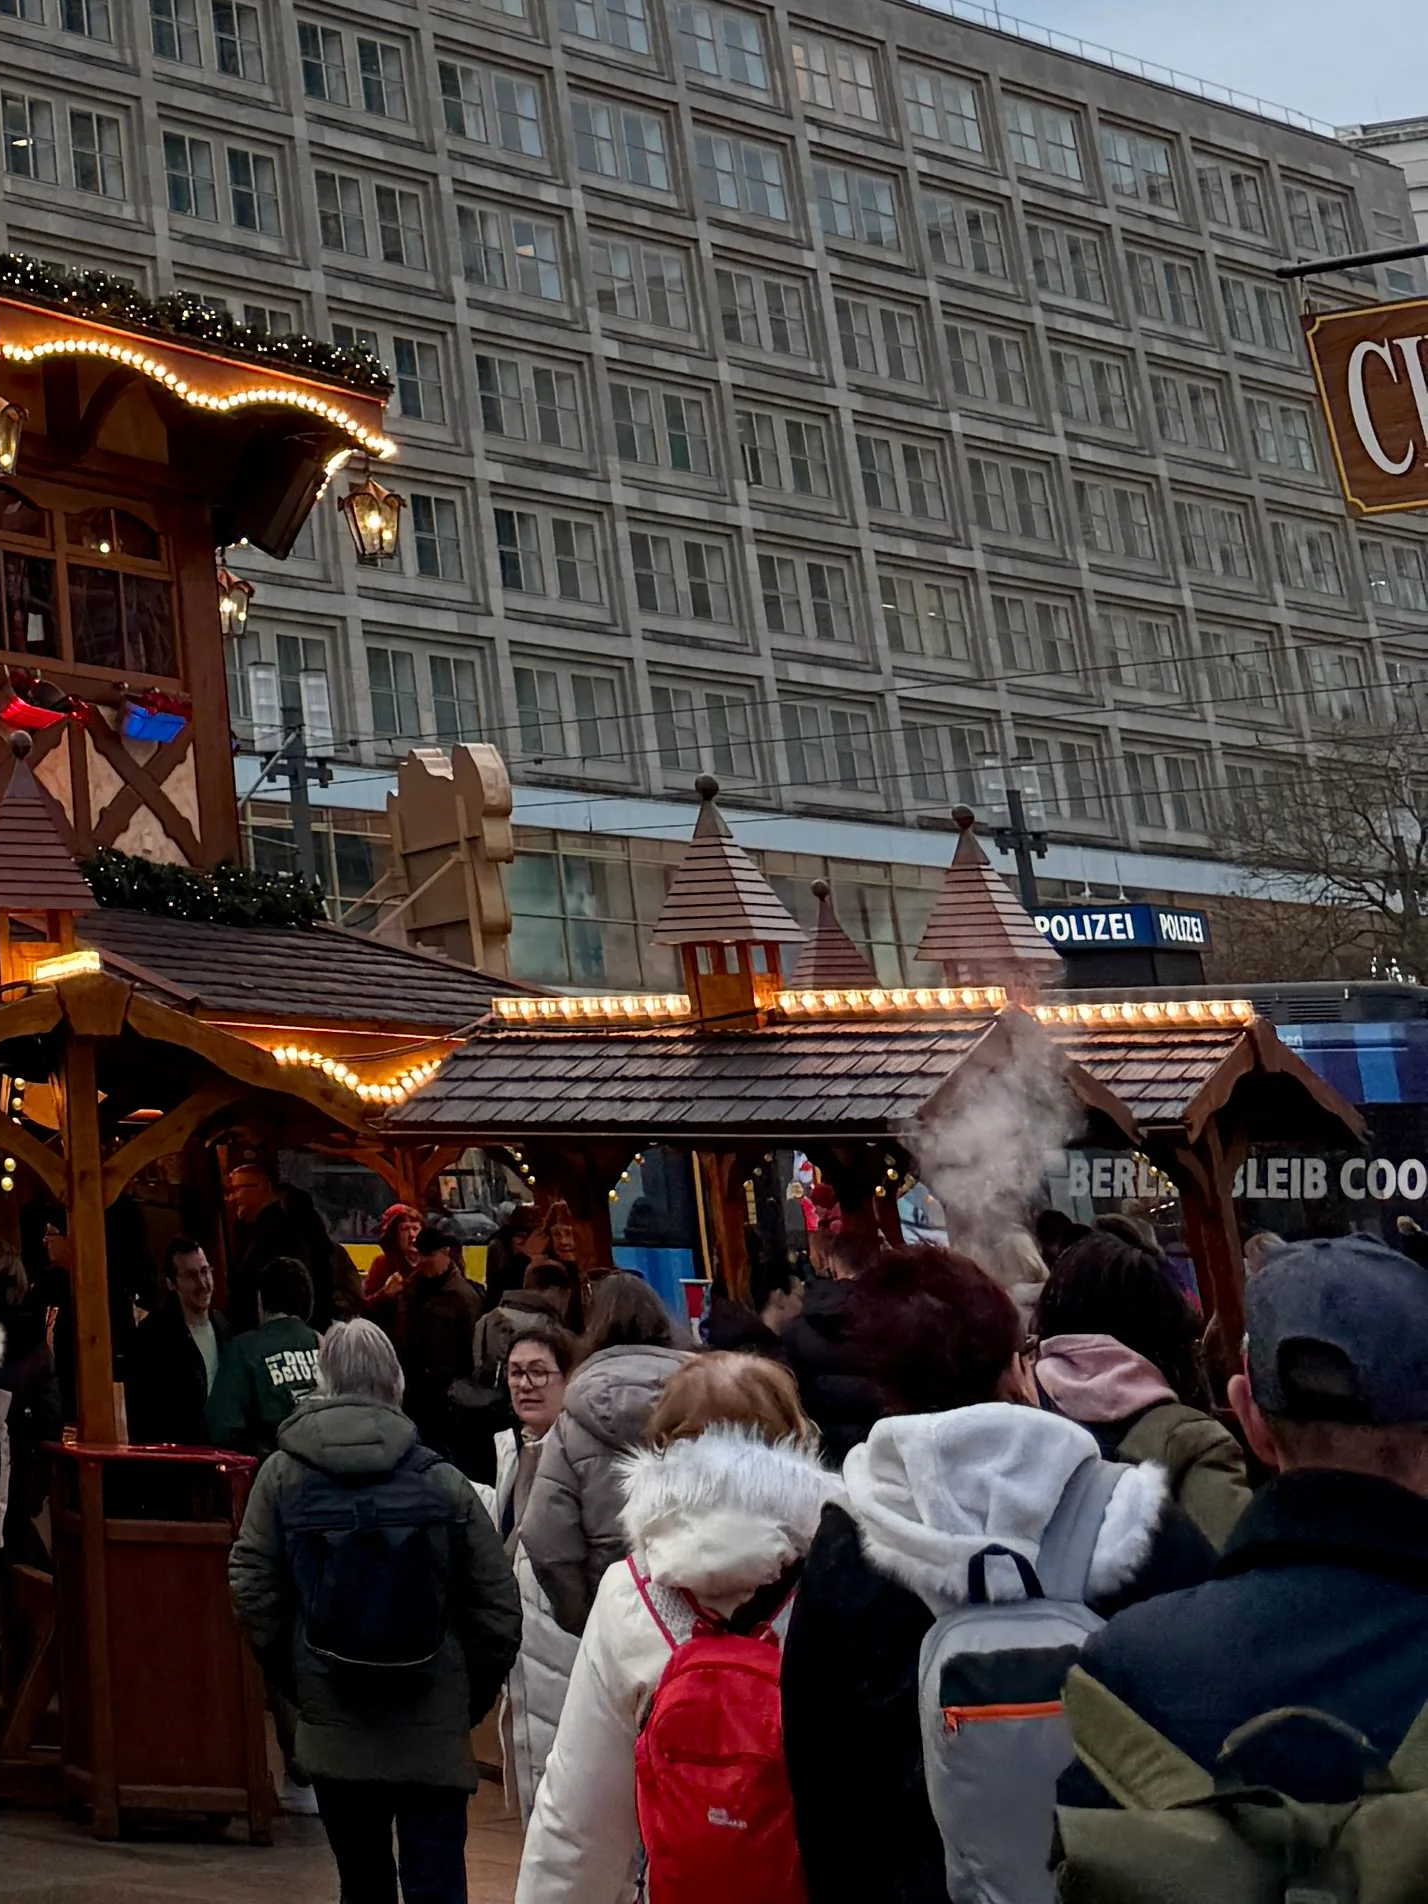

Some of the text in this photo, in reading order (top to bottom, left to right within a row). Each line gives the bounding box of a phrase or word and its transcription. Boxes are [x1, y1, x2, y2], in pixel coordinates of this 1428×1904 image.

[1034, 912, 1135, 941] POLIZEI
[1159, 913, 1204, 943] POLIZEI
[1068, 1158, 1180, 1198] BERL
[1340, 1157, 1427, 1200] COO
